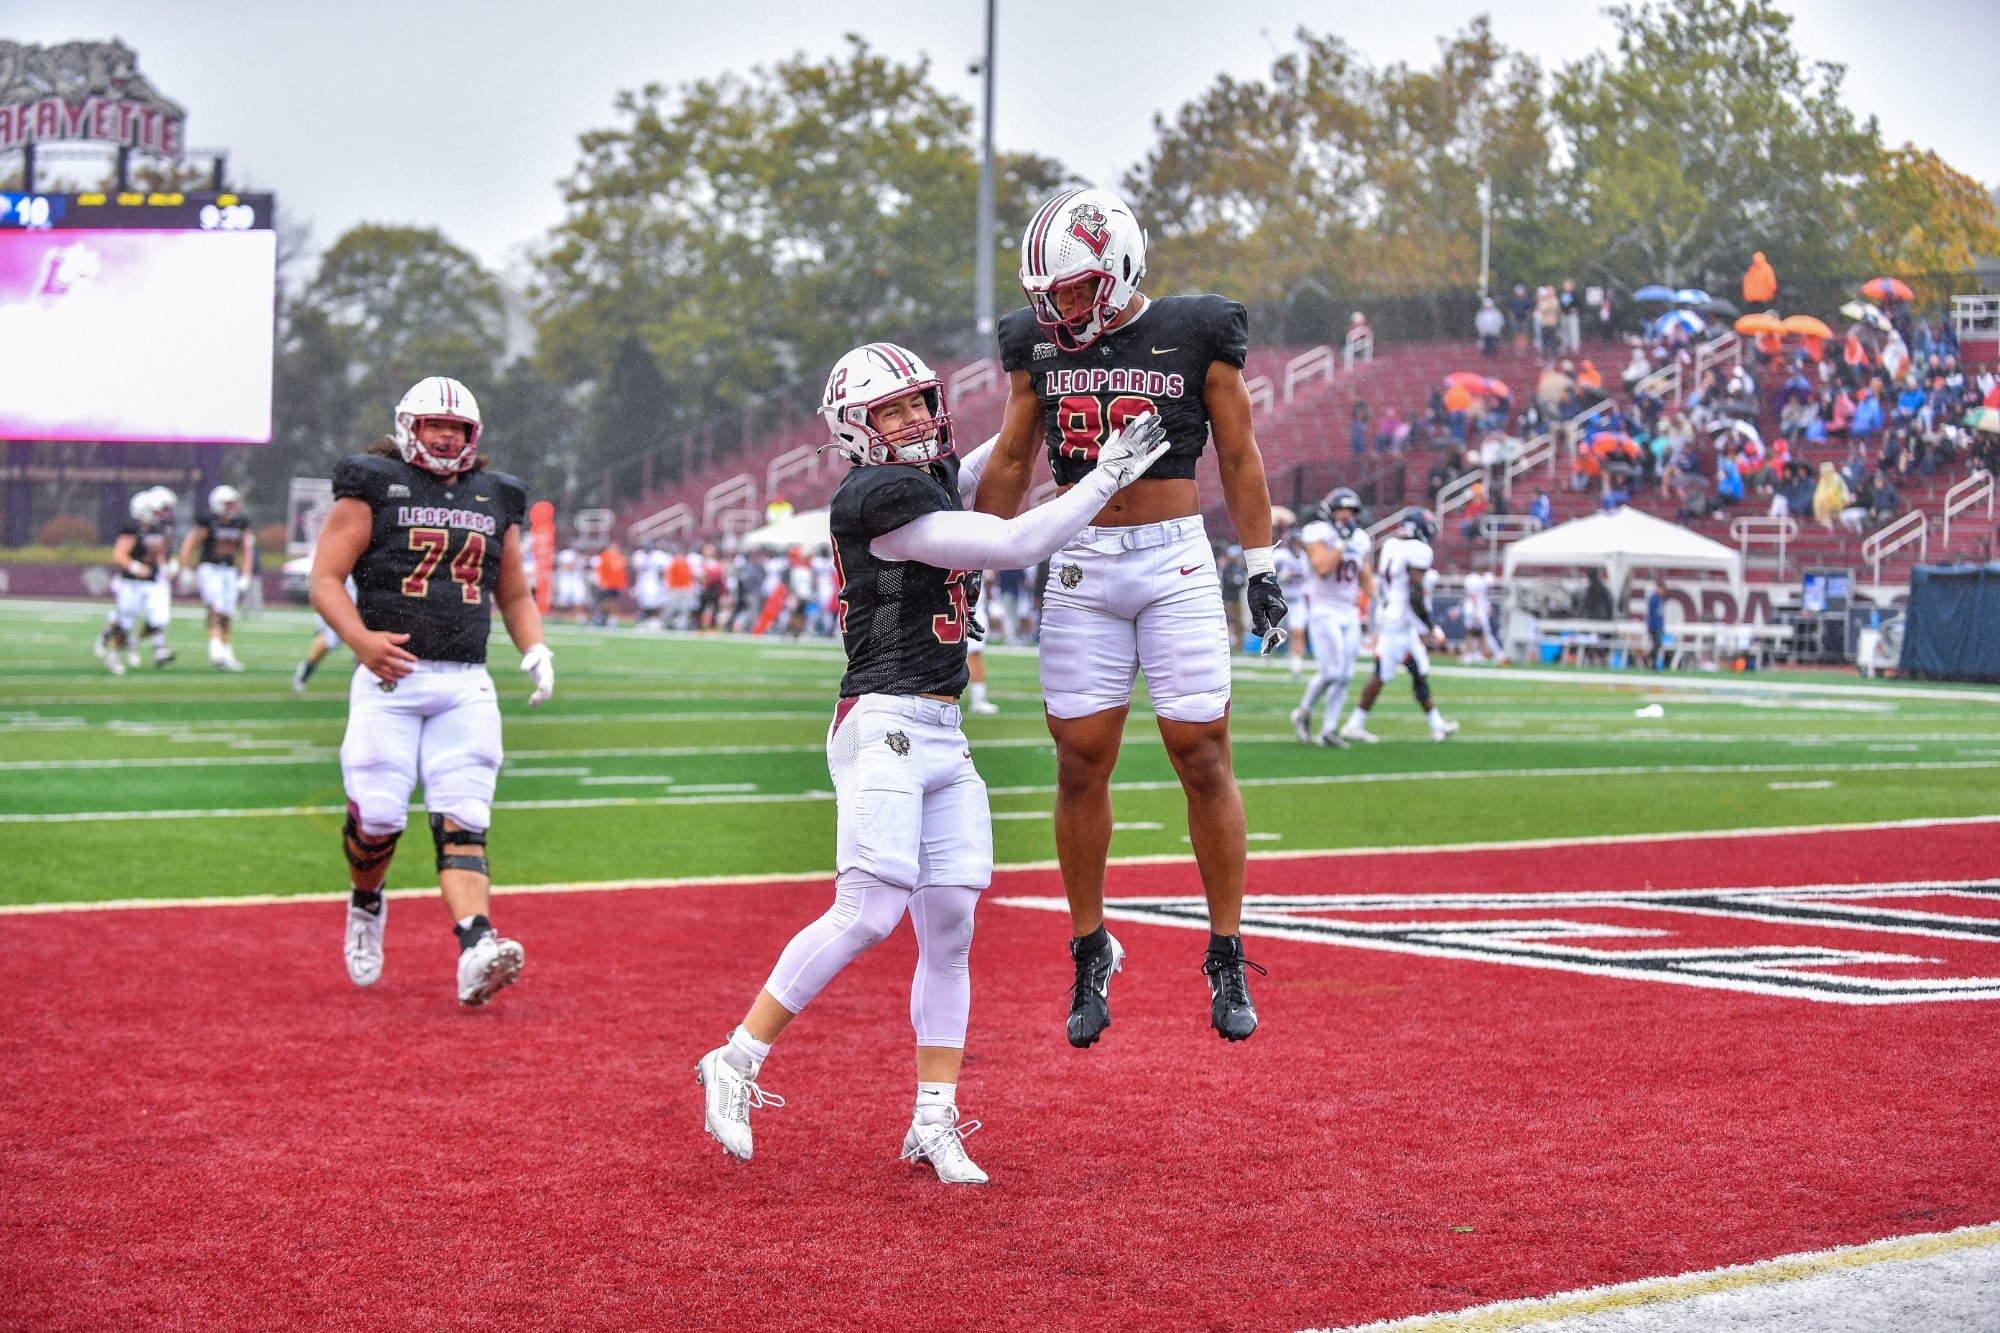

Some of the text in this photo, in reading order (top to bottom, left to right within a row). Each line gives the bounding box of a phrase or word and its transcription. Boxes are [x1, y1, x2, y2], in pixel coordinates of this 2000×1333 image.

[826, 367, 848, 406] 32
[1046, 368, 1184, 398] LEOPARDS
[397, 506, 496, 536] LEOPARDS
[401, 527, 486, 605] 74
[932, 569, 968, 644] 3
